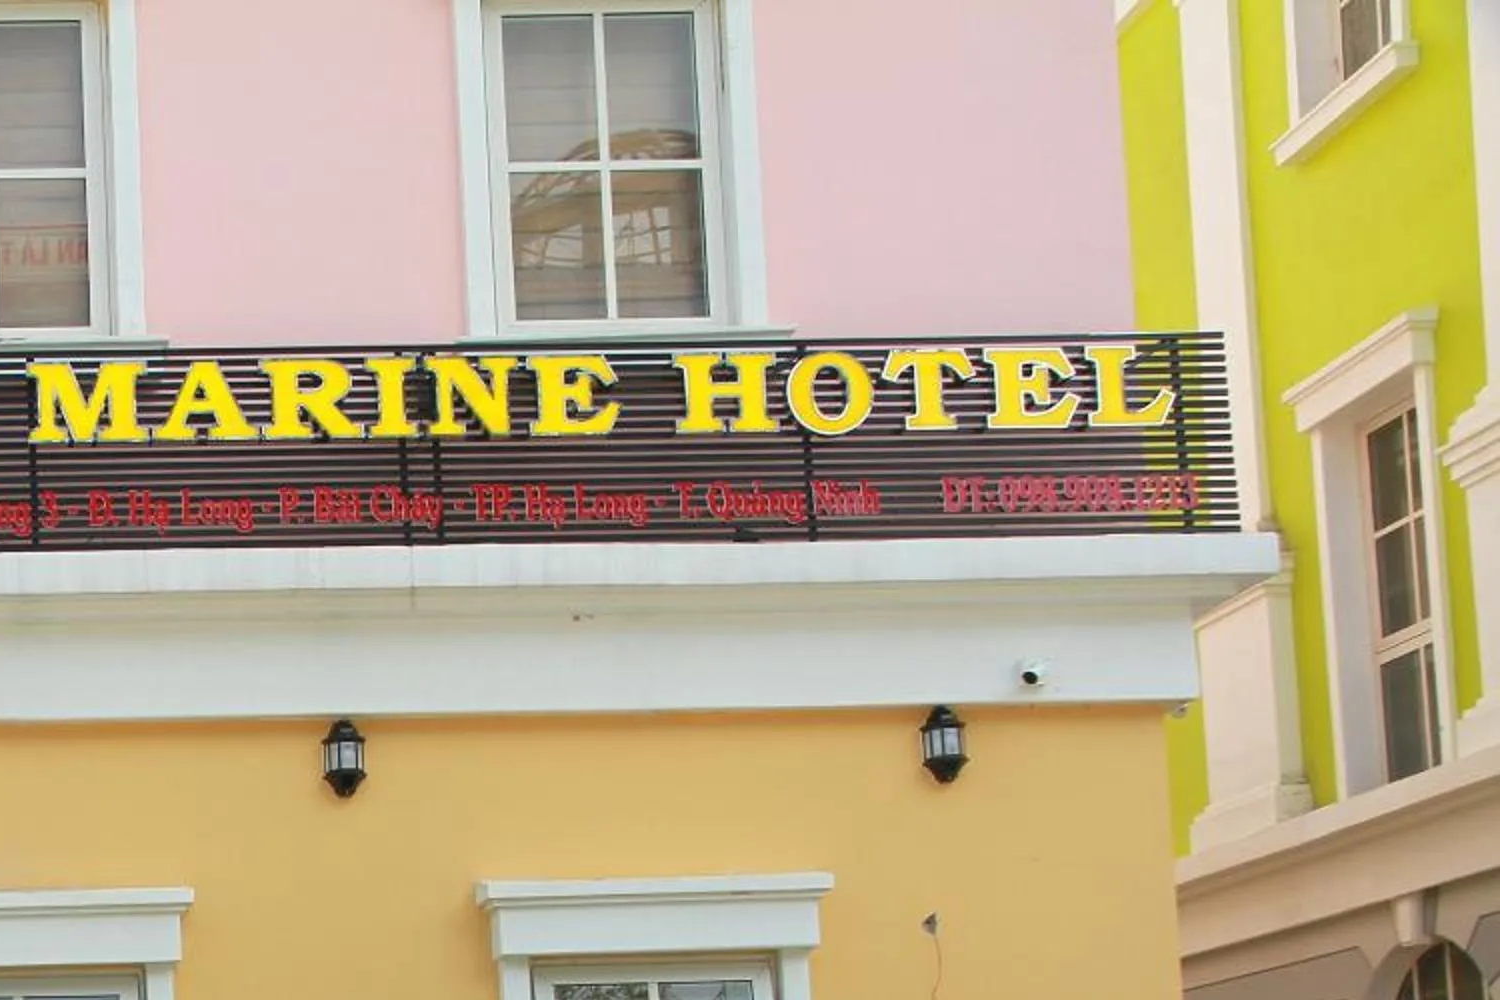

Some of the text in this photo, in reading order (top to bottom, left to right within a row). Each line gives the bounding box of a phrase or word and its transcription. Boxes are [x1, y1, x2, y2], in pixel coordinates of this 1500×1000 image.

[26, 353, 622, 443] MARINE
[673, 345, 1176, 436] HOTEL
[39, 489, 60, 529] 3
[127, 488, 171, 538] Hạ
[180, 486, 255, 533] Long
[370, 483, 444, 532] Cháy
[523, 482, 566, 531] Hạ
[573, 482, 648, 528] Long
[705, 479, 807, 525] Quảng
[810, 479, 882, 517] Ninh
